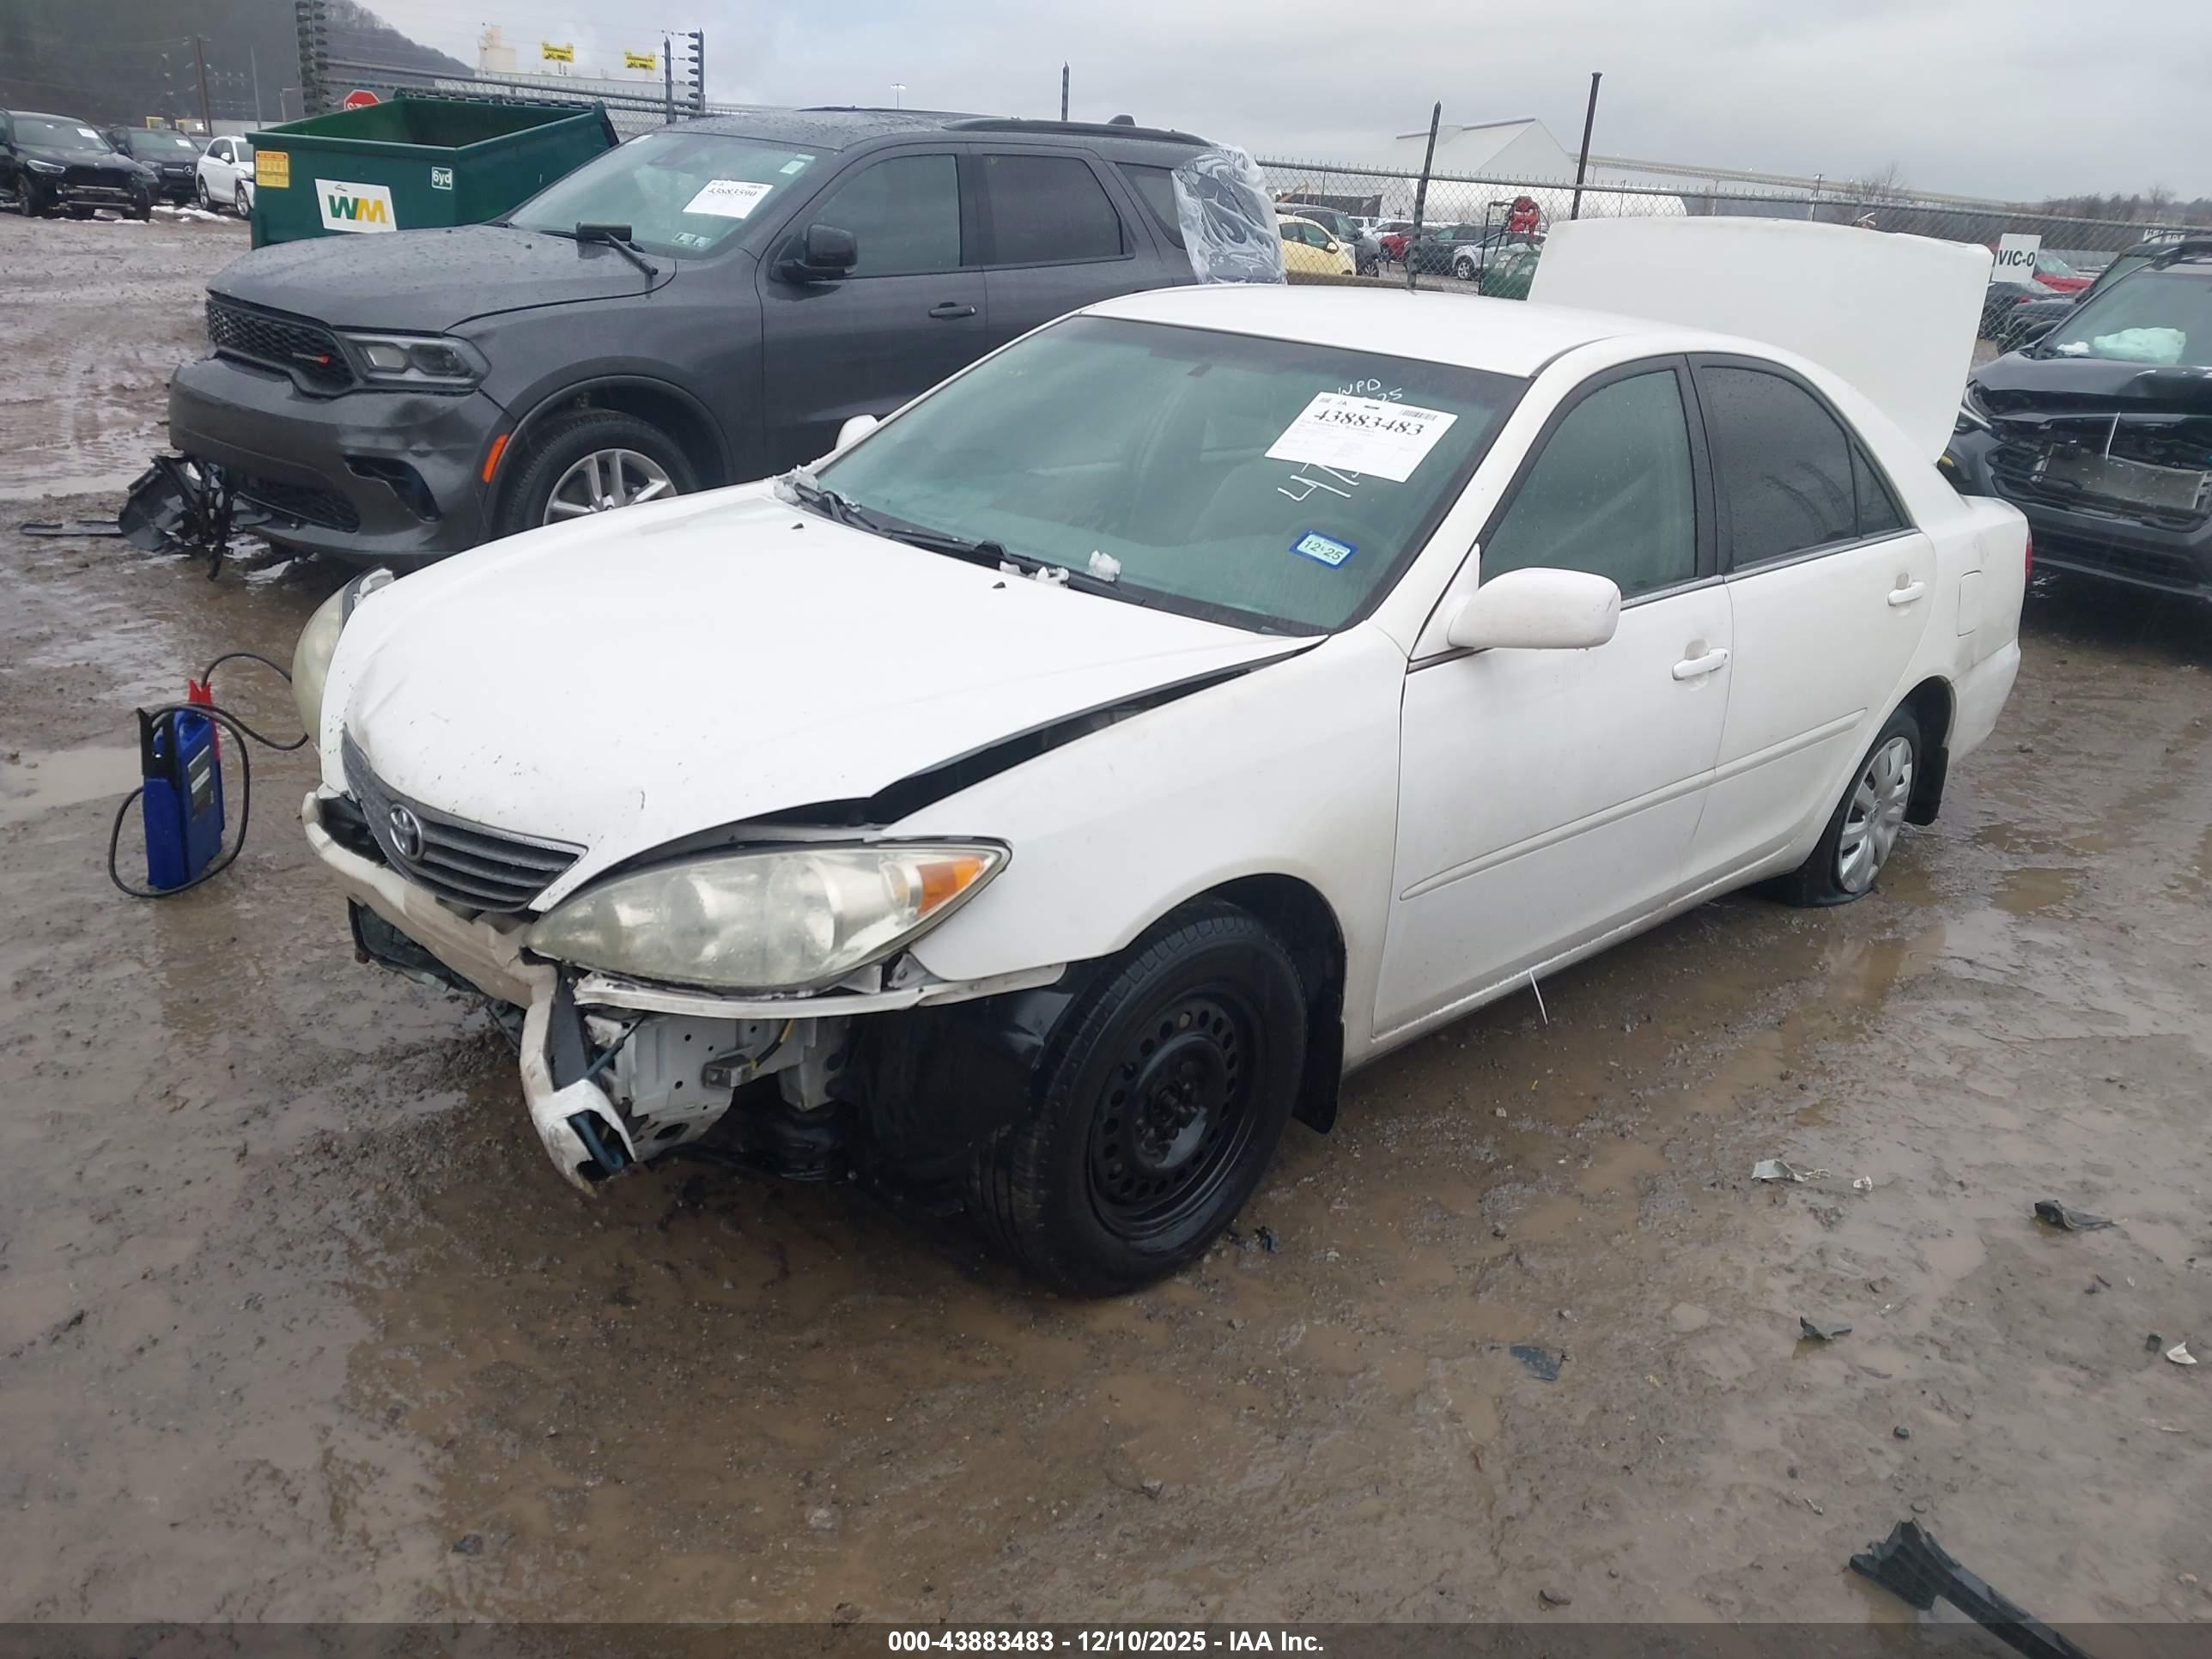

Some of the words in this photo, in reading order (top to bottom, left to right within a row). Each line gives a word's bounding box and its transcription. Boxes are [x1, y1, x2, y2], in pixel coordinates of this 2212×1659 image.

[434, 171, 453, 185] 6yd
[328, 195, 386, 224] WM
[1314, 408, 1425, 436] 43883483
